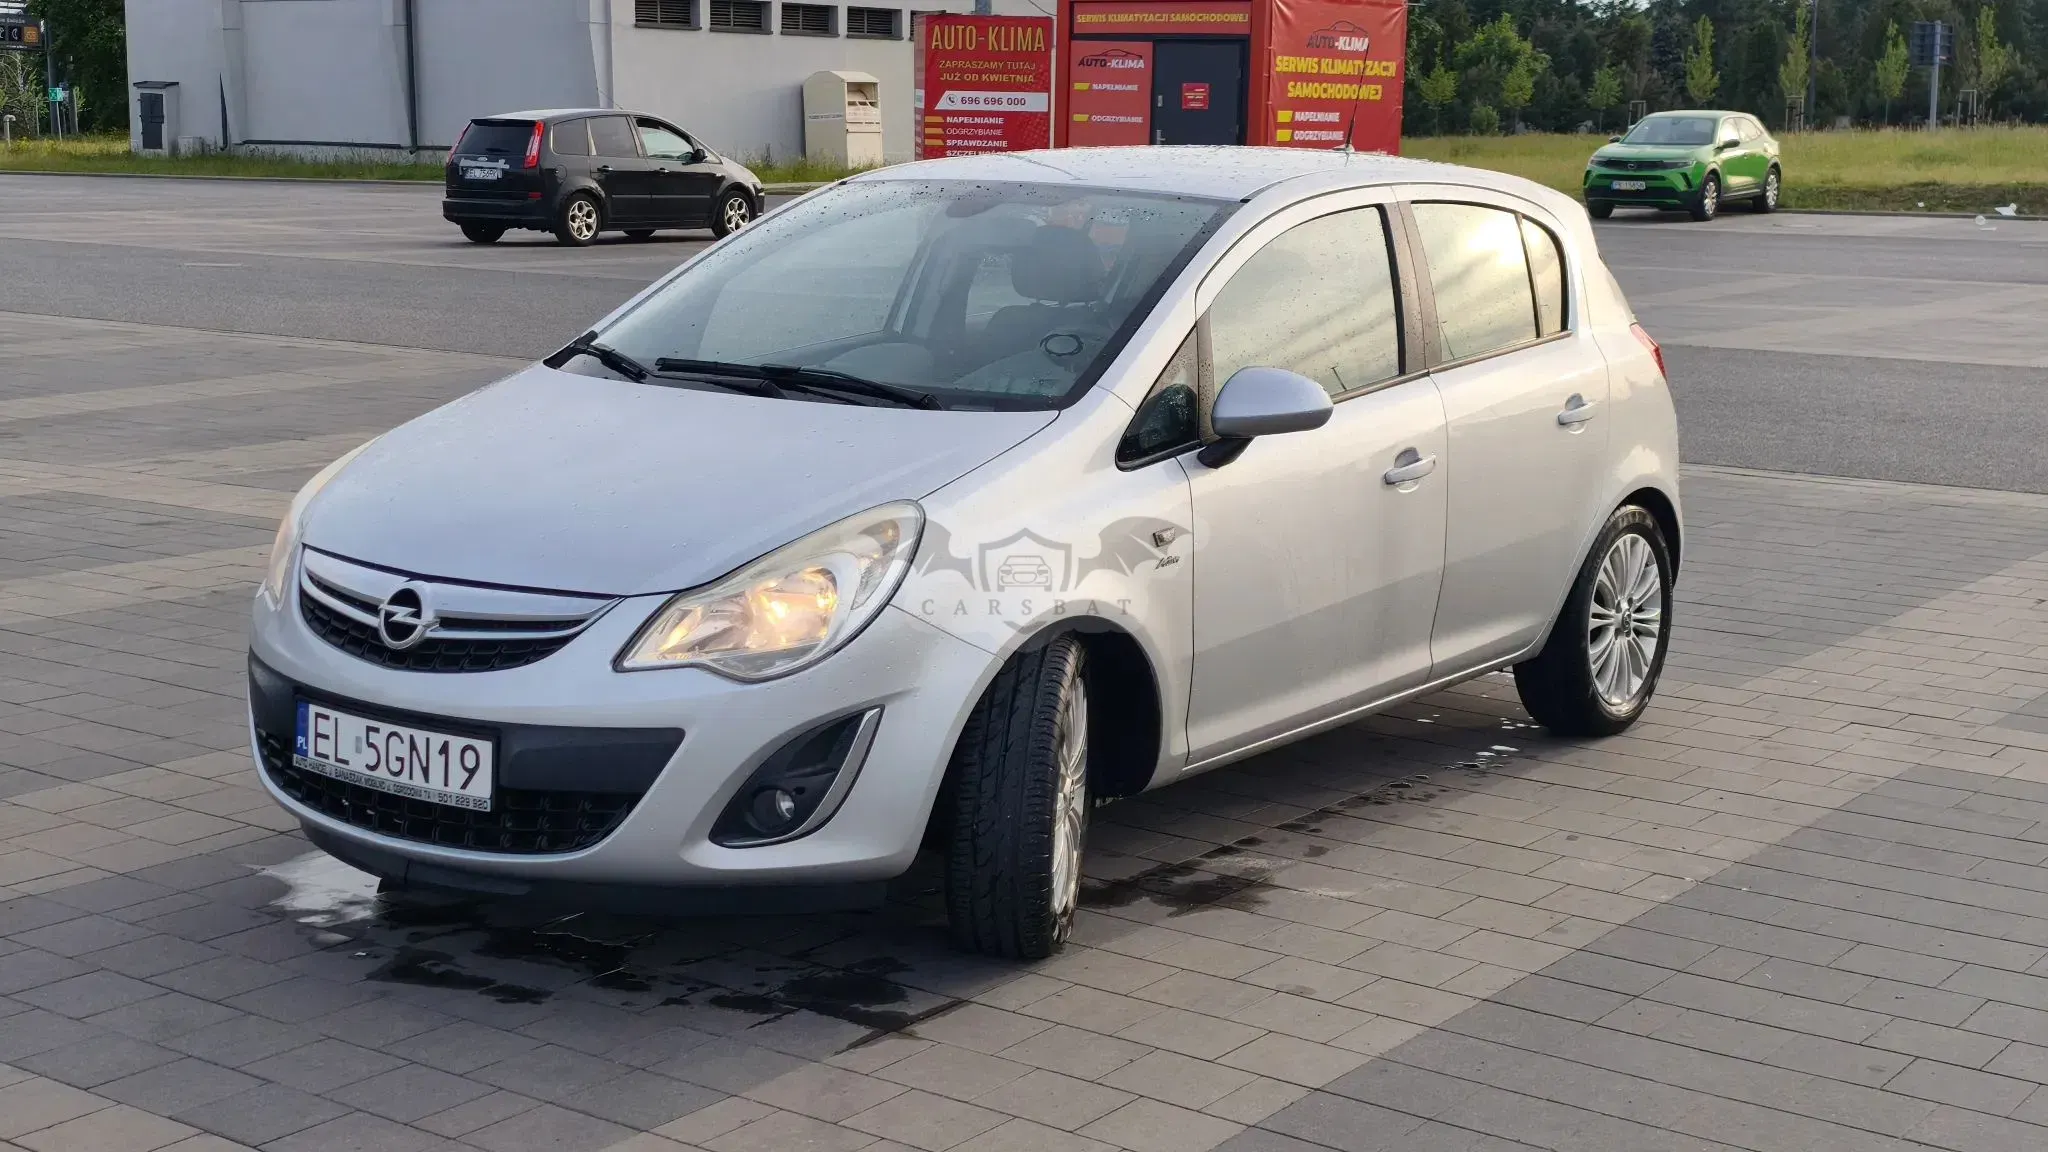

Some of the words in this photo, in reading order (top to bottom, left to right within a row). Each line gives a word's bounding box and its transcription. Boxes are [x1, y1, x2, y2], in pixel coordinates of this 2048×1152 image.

[1077, 14, 1107, 23] SERWIS
[1108, 14, 1168, 23] KLIMATYZACJI
[1170, 13, 1248, 22] SAMOCHODOWEJ
[939, 60, 1004, 70] ZAPRASZAMY
[1007, 61, 1036, 70] TUTAJ
[1078, 58, 1145, 69] AUTO-KLIMA
[1275, 55, 1319, 74] SERWIS
[940, 72, 961, 81] JUŻ
[964, 73, 979, 82] OD
[982, 73, 1034, 83] KWIETNIA
[1287, 81, 1383, 100] SAMOCHODOWEJ
[961, 96, 980, 105] 696
[983, 96, 1004, 106] 696
[1006, 97, 1026, 106] 000
[946, 127, 1004, 136] ODGRZYBIANIE
[946, 139, 1008, 148] SPRAWDZANIE
[297, 735, 308, 750] PL
[314, 711, 350, 766] EL
[365, 725, 481, 790] 5GN19
